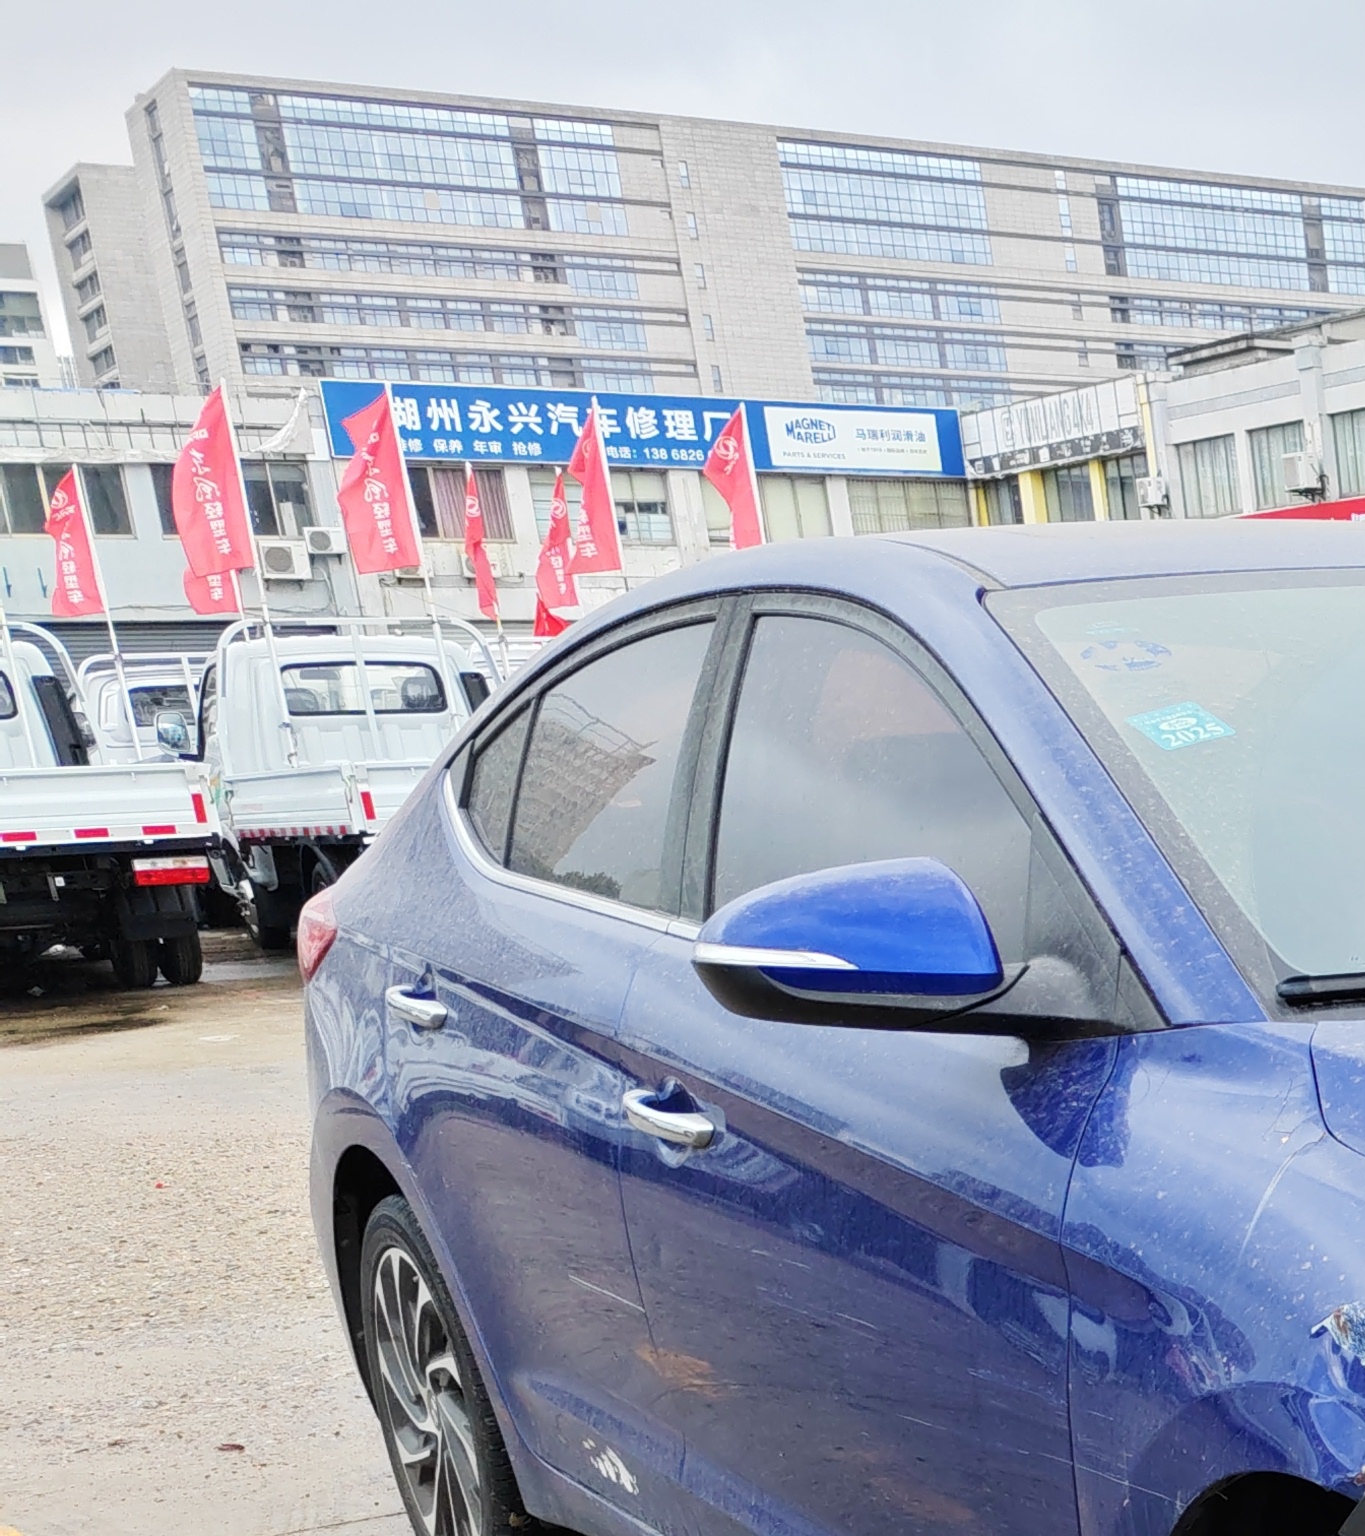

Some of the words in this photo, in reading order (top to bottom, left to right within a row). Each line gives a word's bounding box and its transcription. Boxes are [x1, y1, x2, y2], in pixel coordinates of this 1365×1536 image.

[390, 396, 732, 442] 湖州永兴汽车修理厂
[855, 427, 926, 443] 马瑞利润滑油
[433, 439, 464, 454] 保养
[473, 440, 503, 455] 年审
[512, 441, 542, 456] 抢修
[644, 447, 667, 460] 138
[672, 448, 705, 461] 6826
[1161, 722, 1225, 747] 2025
